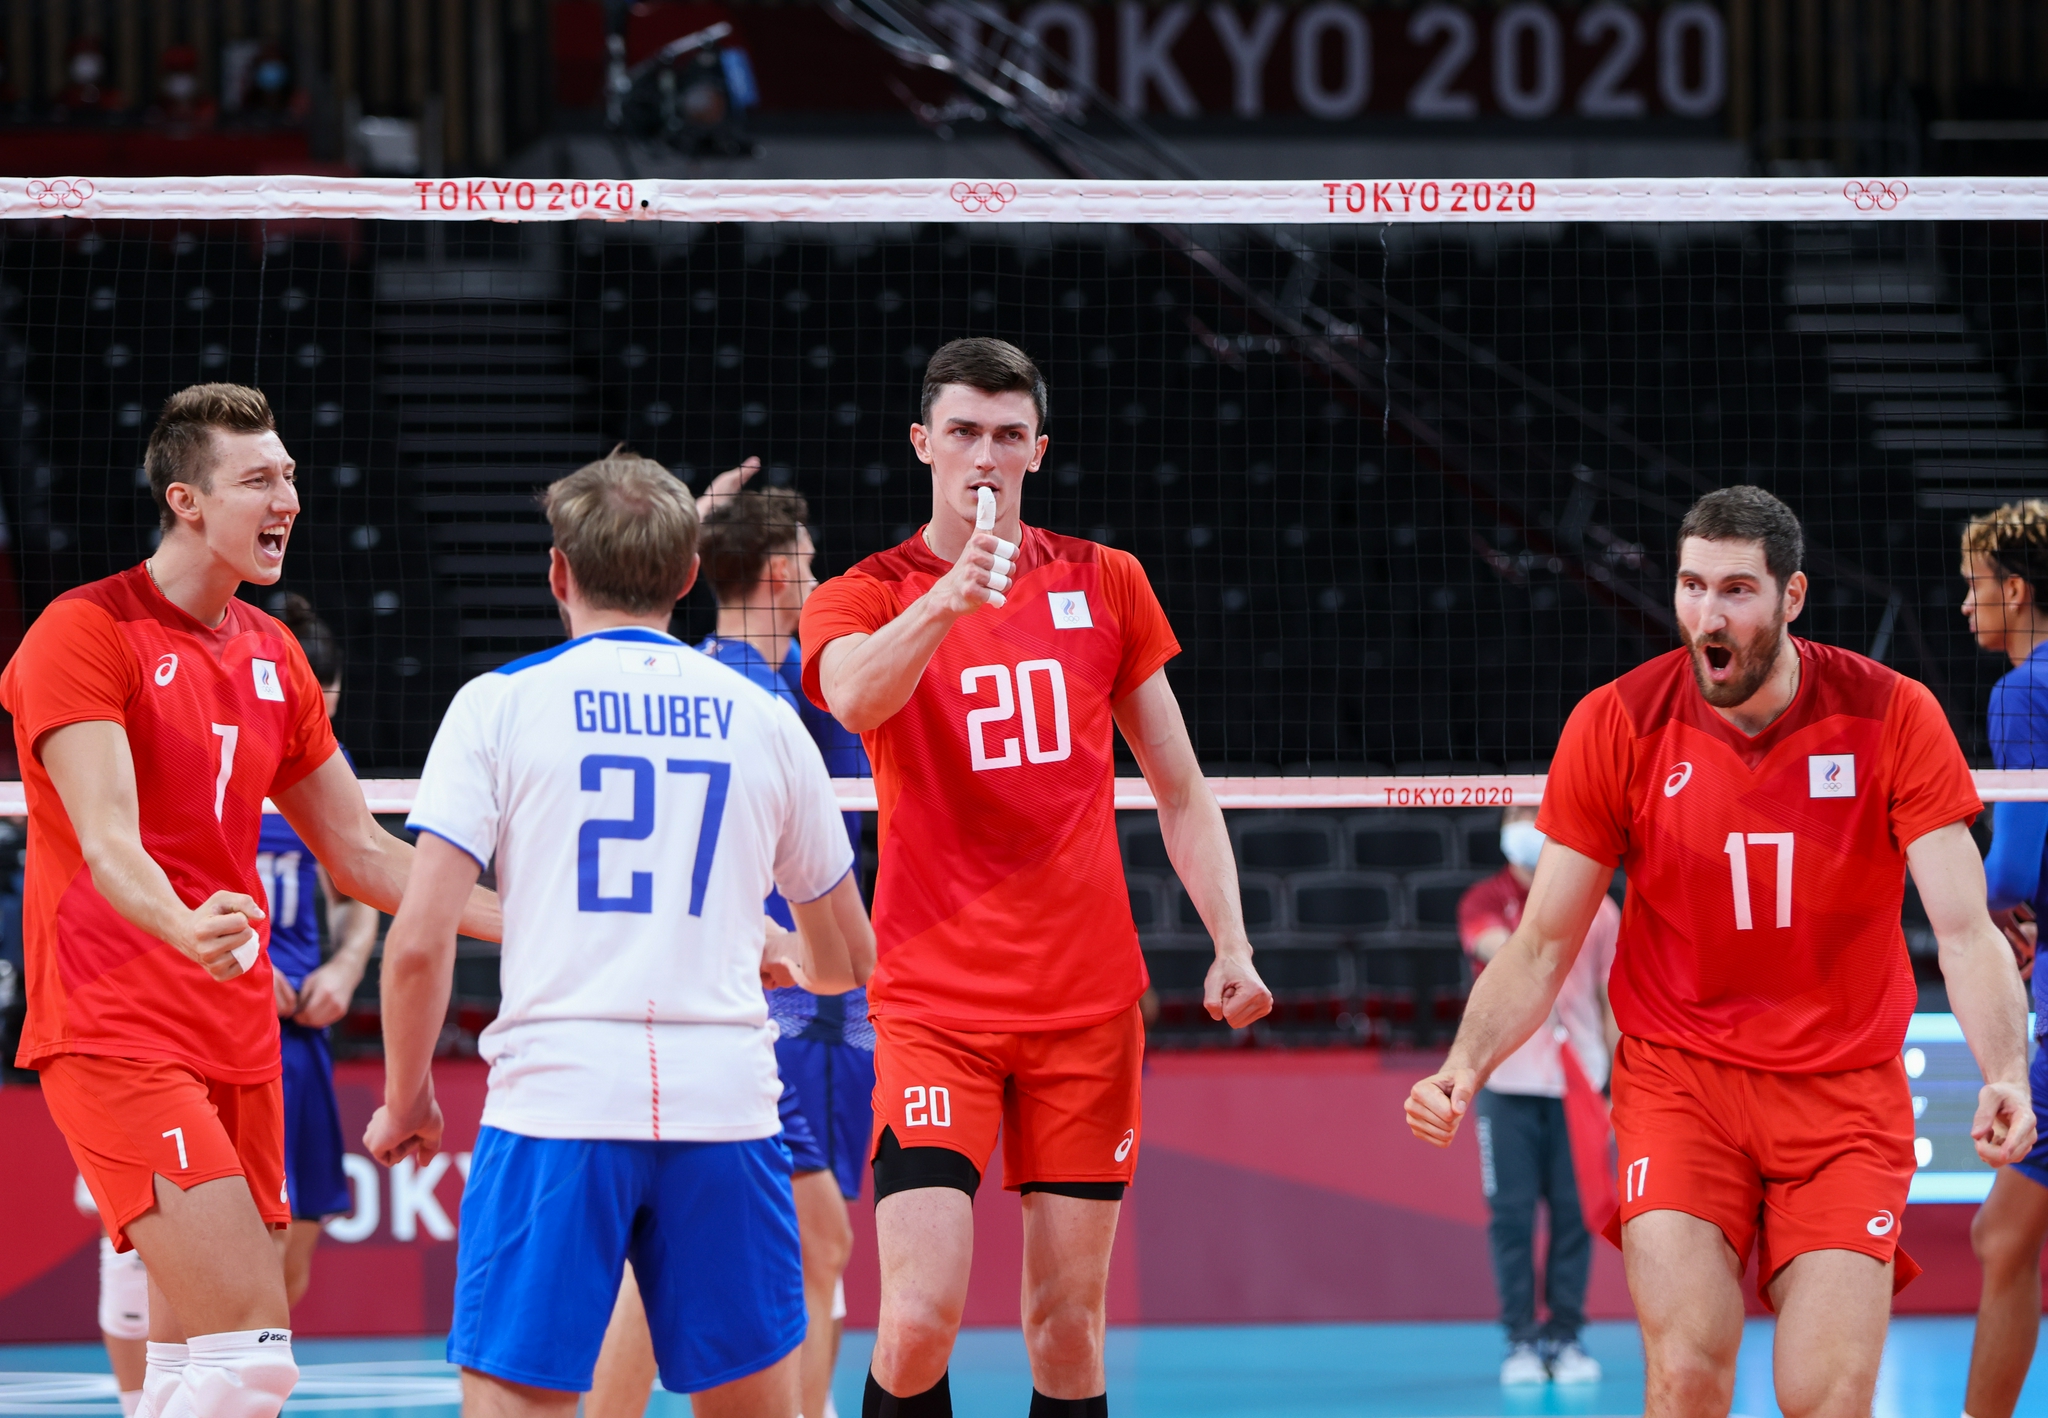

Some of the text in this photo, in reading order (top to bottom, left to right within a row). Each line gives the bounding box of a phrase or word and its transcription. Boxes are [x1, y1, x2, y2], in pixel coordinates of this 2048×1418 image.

[1407, 4, 1728, 118] 2020
[415, 181, 634, 211] TOKYO 2020
[1322, 181, 1536, 213] TOKYO 2020
[574, 690, 733, 740] GOLUBEV
[960, 658, 1072, 772] 20
[1384, 787, 1513, 805] TOKYO 2020
[577, 753, 732, 918] 27
[1723, 832, 1795, 931] 17
[904, 1085, 951, 1127] 20
[161, 1126, 189, 1170] 7
[324, 1152, 473, 1243] OK
[1626, 1156, 1650, 1203] 17
